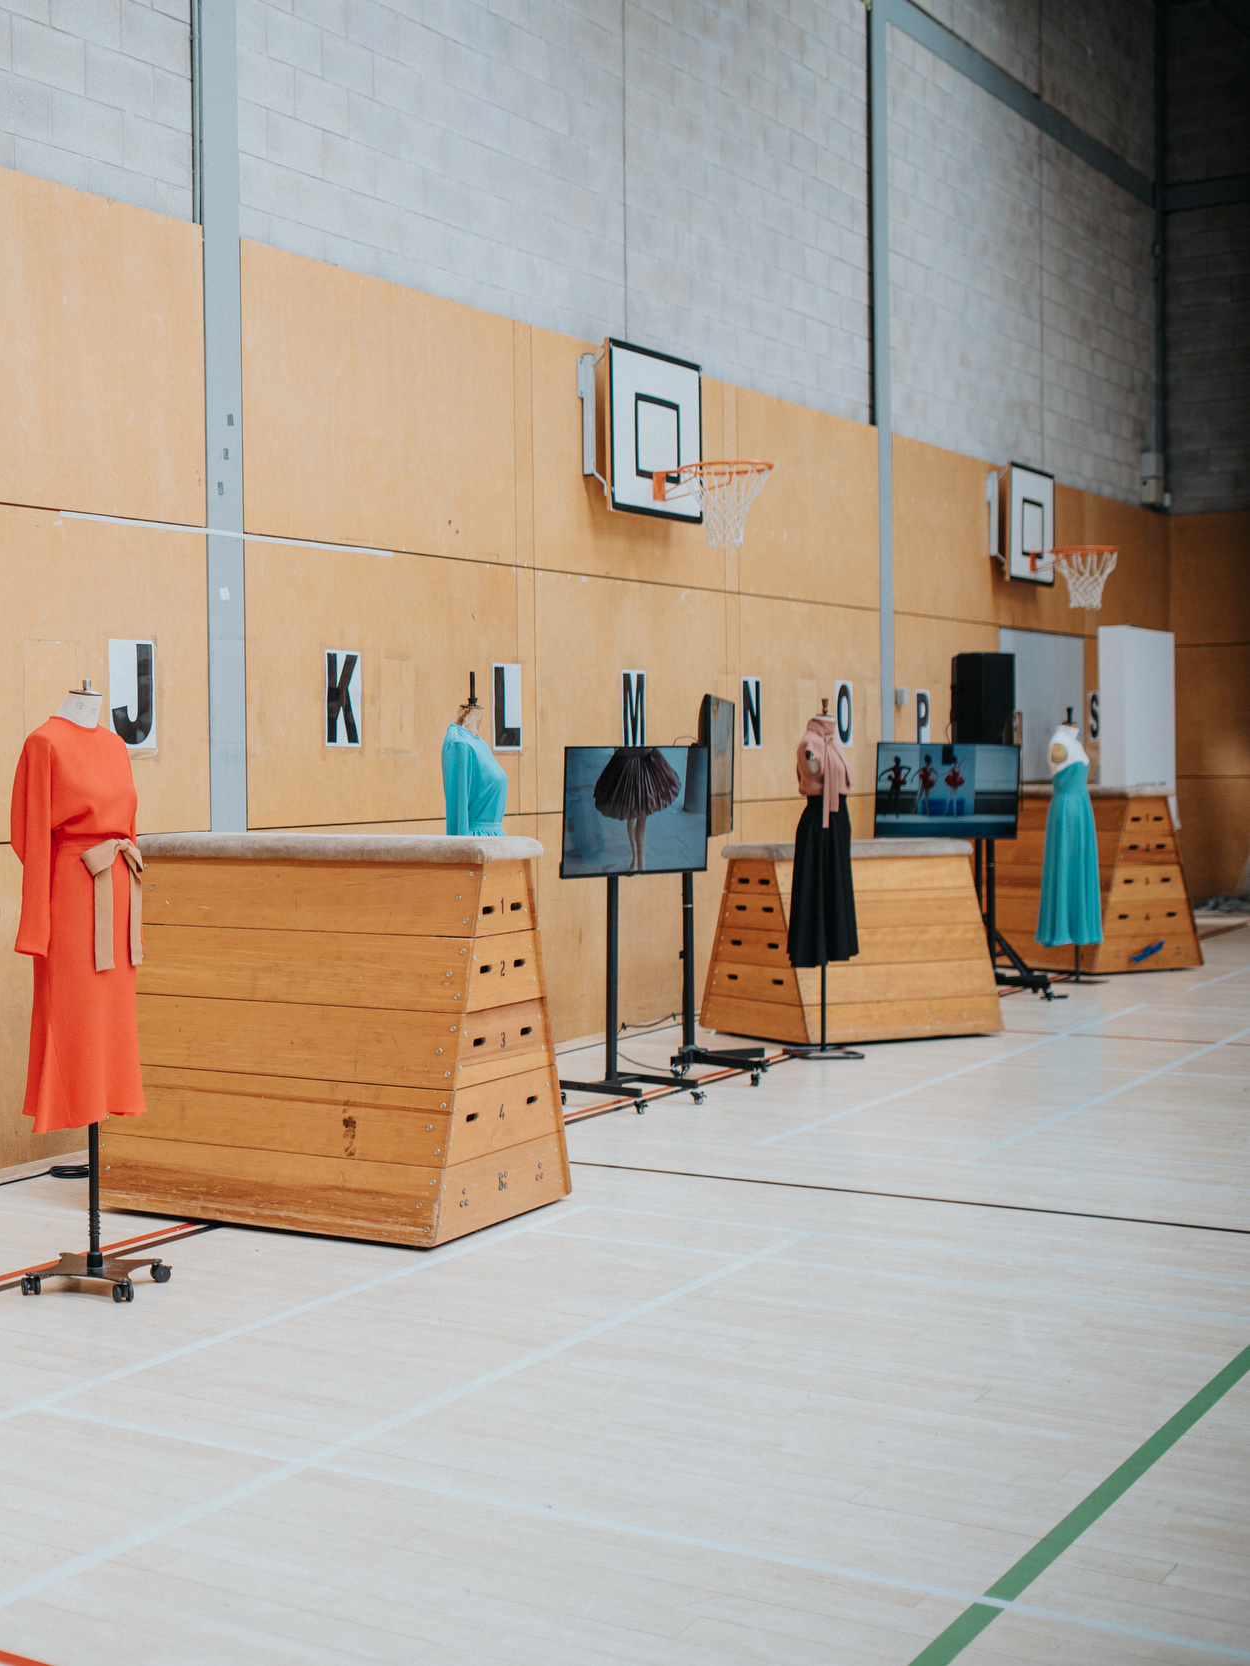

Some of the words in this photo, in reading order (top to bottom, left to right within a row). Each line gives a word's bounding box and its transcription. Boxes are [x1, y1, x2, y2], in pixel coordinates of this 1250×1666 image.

[112, 644, 152, 745] J
[325, 652, 359, 743] K
[494, 666, 521, 747] L
[623, 673, 645, 747] M
[743, 678, 761, 746] N
[838, 684, 853, 744] O
[916, 693, 929, 743] P
[1091, 693, 1099, 738] S
[501, 898, 505, 914] 1
[500, 961, 506, 976] 2
[501, 1032, 506, 1048] 3
[499, 1104, 505, 1120] 4
